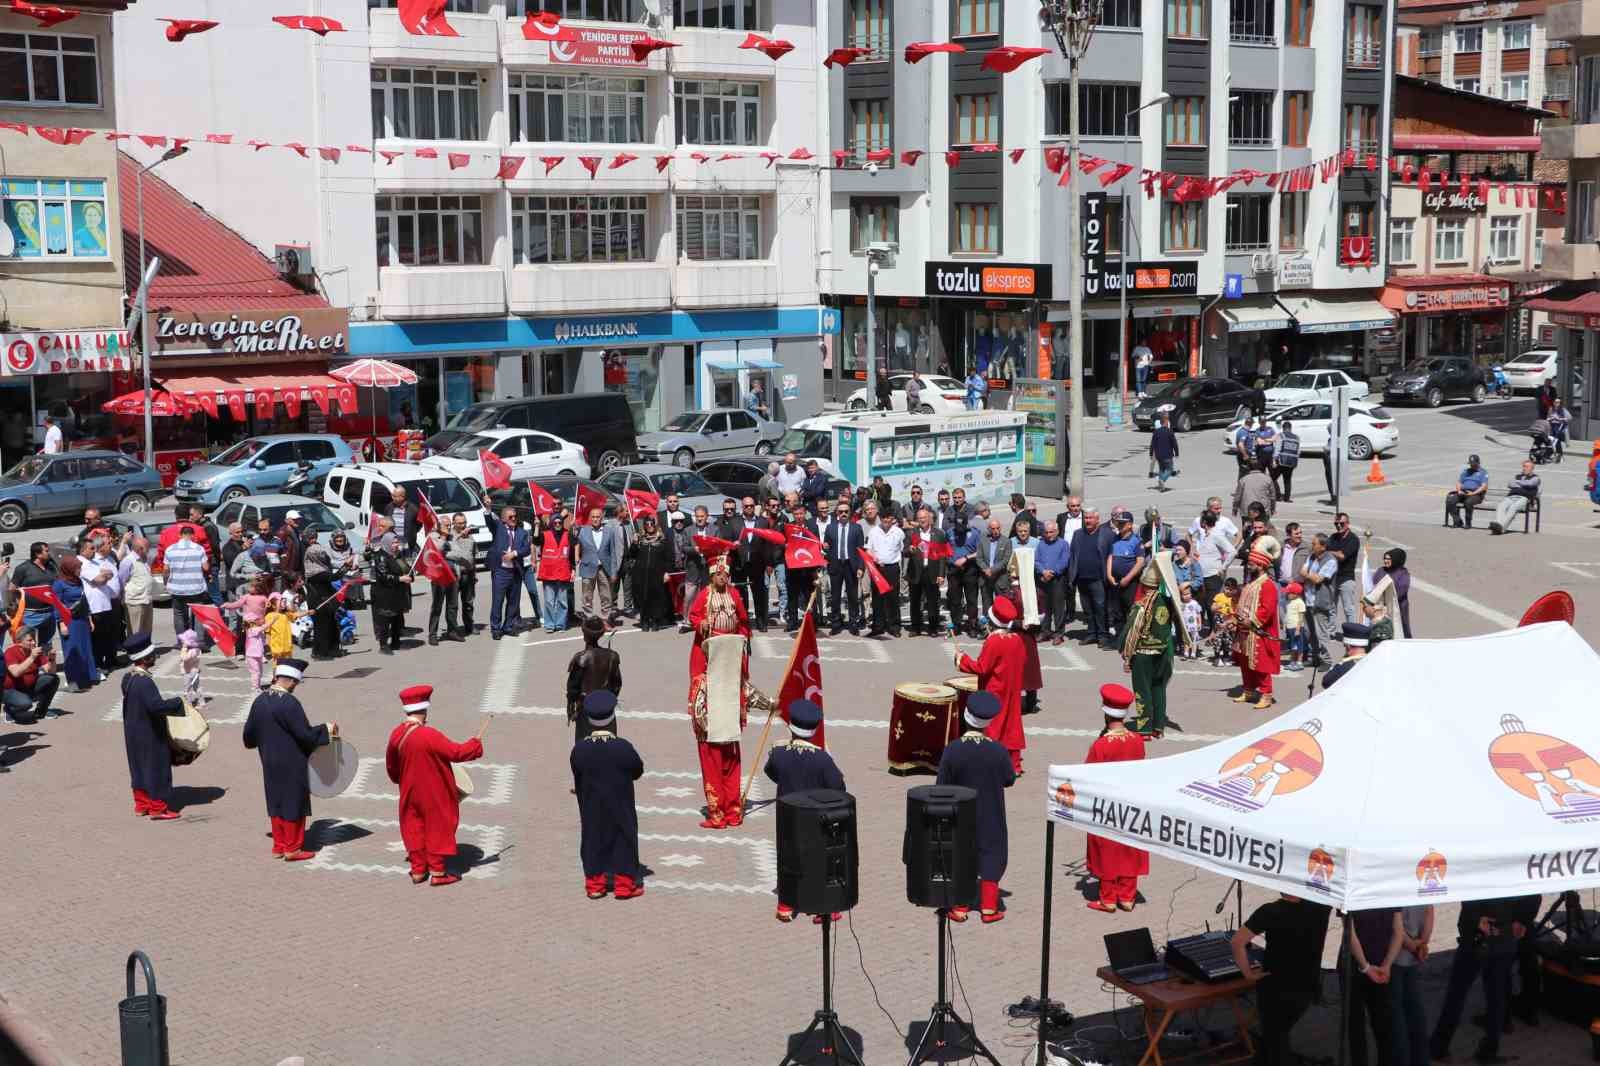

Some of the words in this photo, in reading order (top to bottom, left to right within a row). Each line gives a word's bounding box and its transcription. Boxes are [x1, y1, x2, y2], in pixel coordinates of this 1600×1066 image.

[580, 31, 617, 43] YENİDEN
[598, 44, 629, 57] PARTİSİ
[1426, 190, 1446, 212] Cafe
[1087, 199, 1099, 294] TOZLU
[936, 267, 980, 293] tozlu
[985, 271, 1032, 293] ekspres
[1104, 271, 1135, 290] tozu
[570, 321, 638, 338] HALKBANK
[1091, 796, 1153, 838] HAVZA
[1159, 814, 1285, 874] BELEDİYESİ
[1527, 847, 1600, 880] HAVZ
